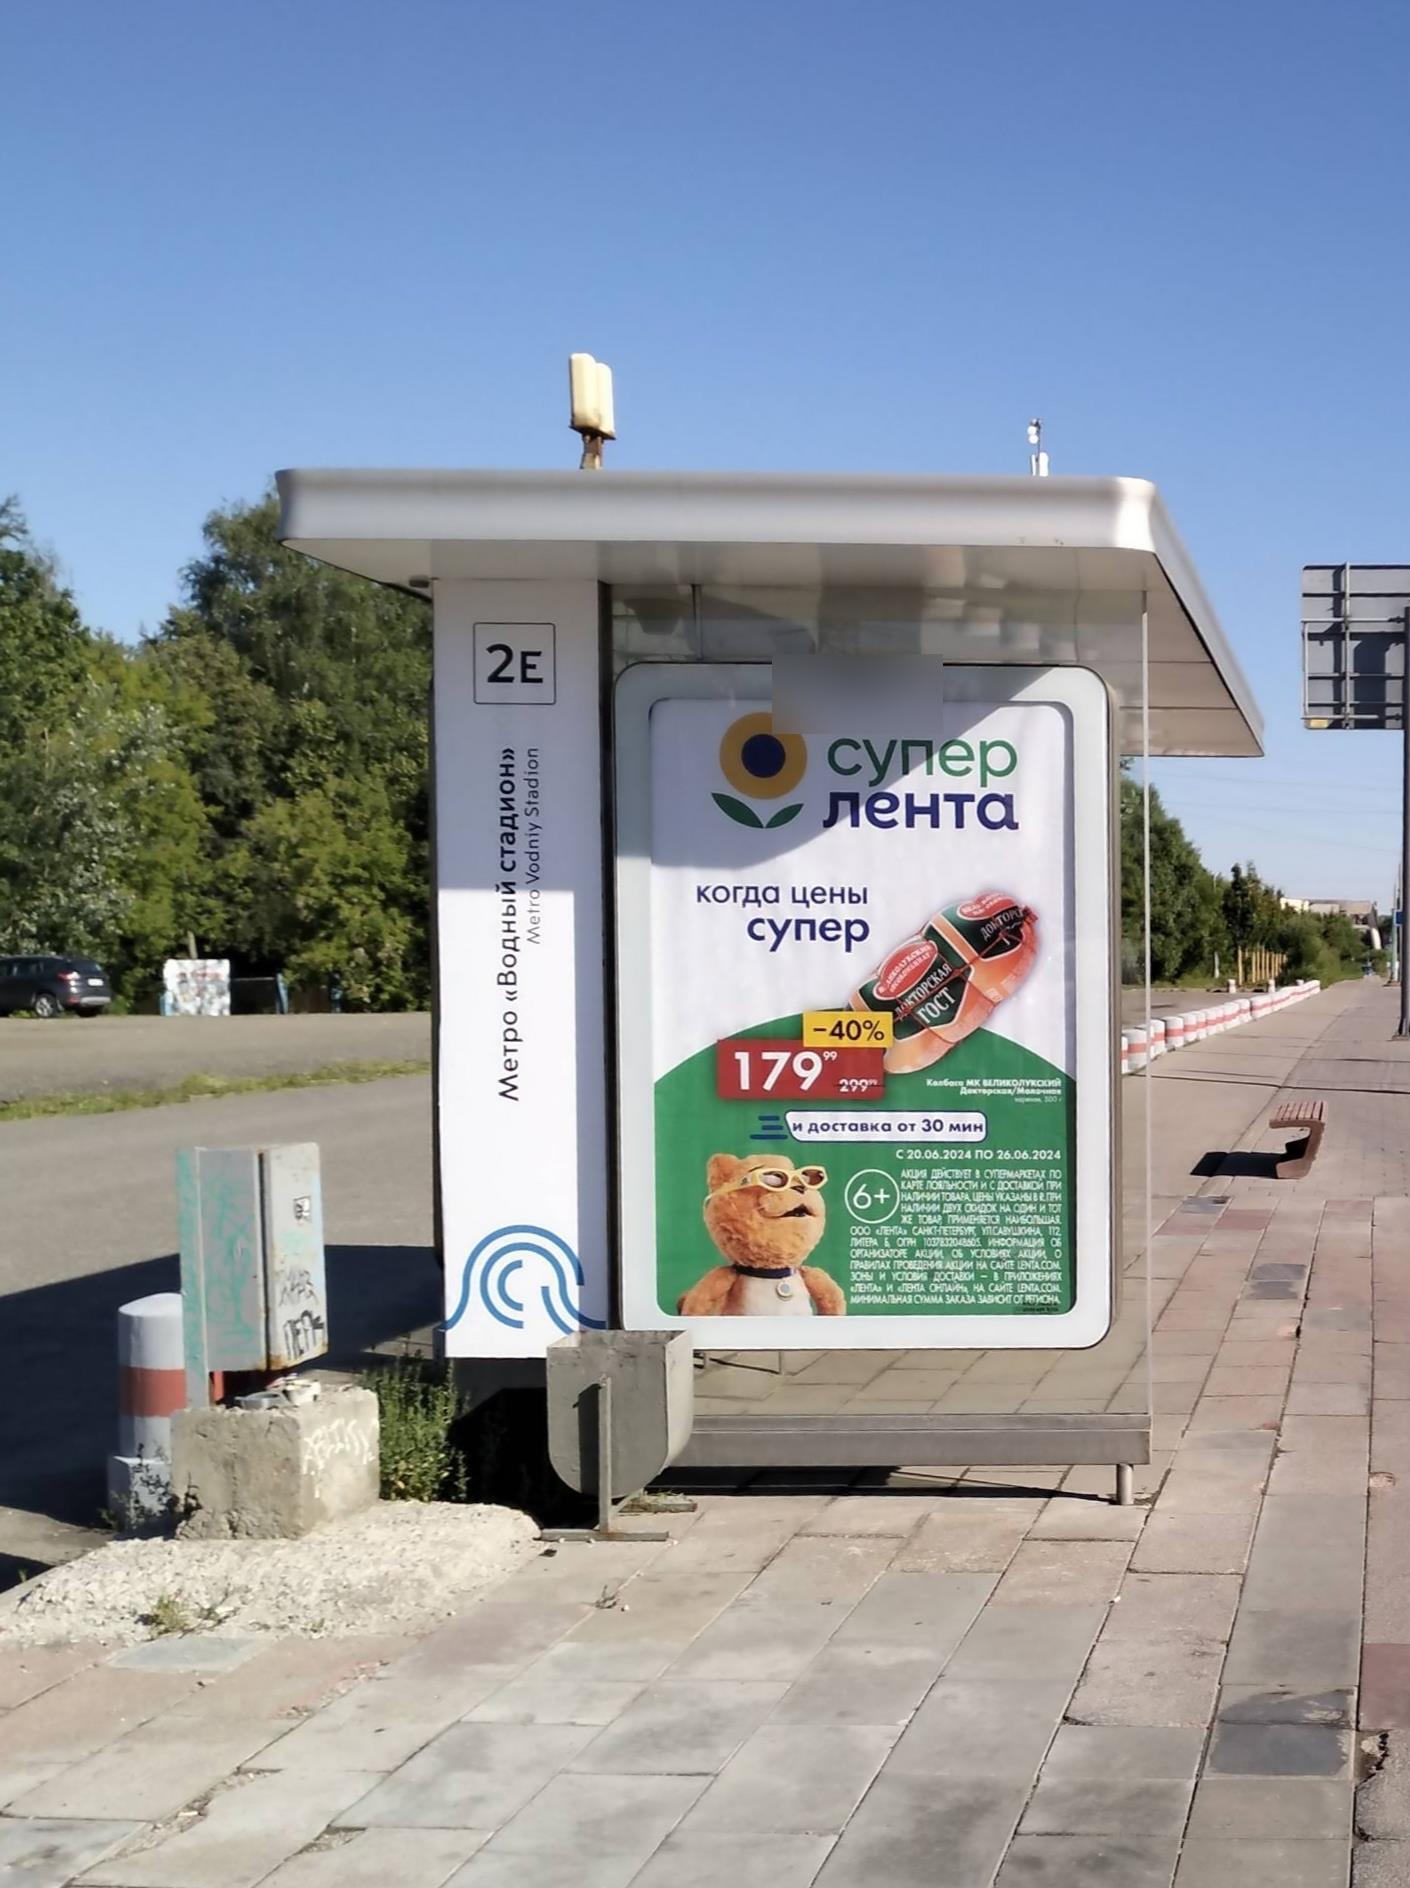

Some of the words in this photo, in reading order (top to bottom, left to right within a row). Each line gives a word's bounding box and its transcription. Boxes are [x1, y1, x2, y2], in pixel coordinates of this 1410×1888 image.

[827, 738, 1018, 787] супер
[524, 747, 540, 817] Stadion
[499, 747, 518, 873] стадион»
[822, 792, 1019, 831] лента
[524, 822, 543, 886] Vodniy
[525, 887, 541, 945] Metro
[696, 885, 780, 908] когда
[791, 885, 869, 909] цены
[497, 881, 521, 1003] «Водный
[746, 917, 870, 953] супер
[916, 986, 955, 1024] ГОСТ
[498, 1009, 523, 1101] Метро
[966, 1079, 981, 1087] МК
[792, 1122, 803, 1132] и
[808, 1121, 892, 1135] доставка
[897, 1122, 917, 1133] от
[921, 1119, 943, 1132] 30
[949, 1121, 984, 1133] мин
[896, 1149, 903, 1160] С
[907, 1149, 971, 1160] 20.06.2024
[975, 1149, 993, 1160] ПО
[998, 1149, 1061, 1160] 26.06.2024
[901, 1169, 927, 1179] АКЦИЯ
[853, 1183, 891, 1210] 6+
[850, 1226, 871, 1236] ООО
